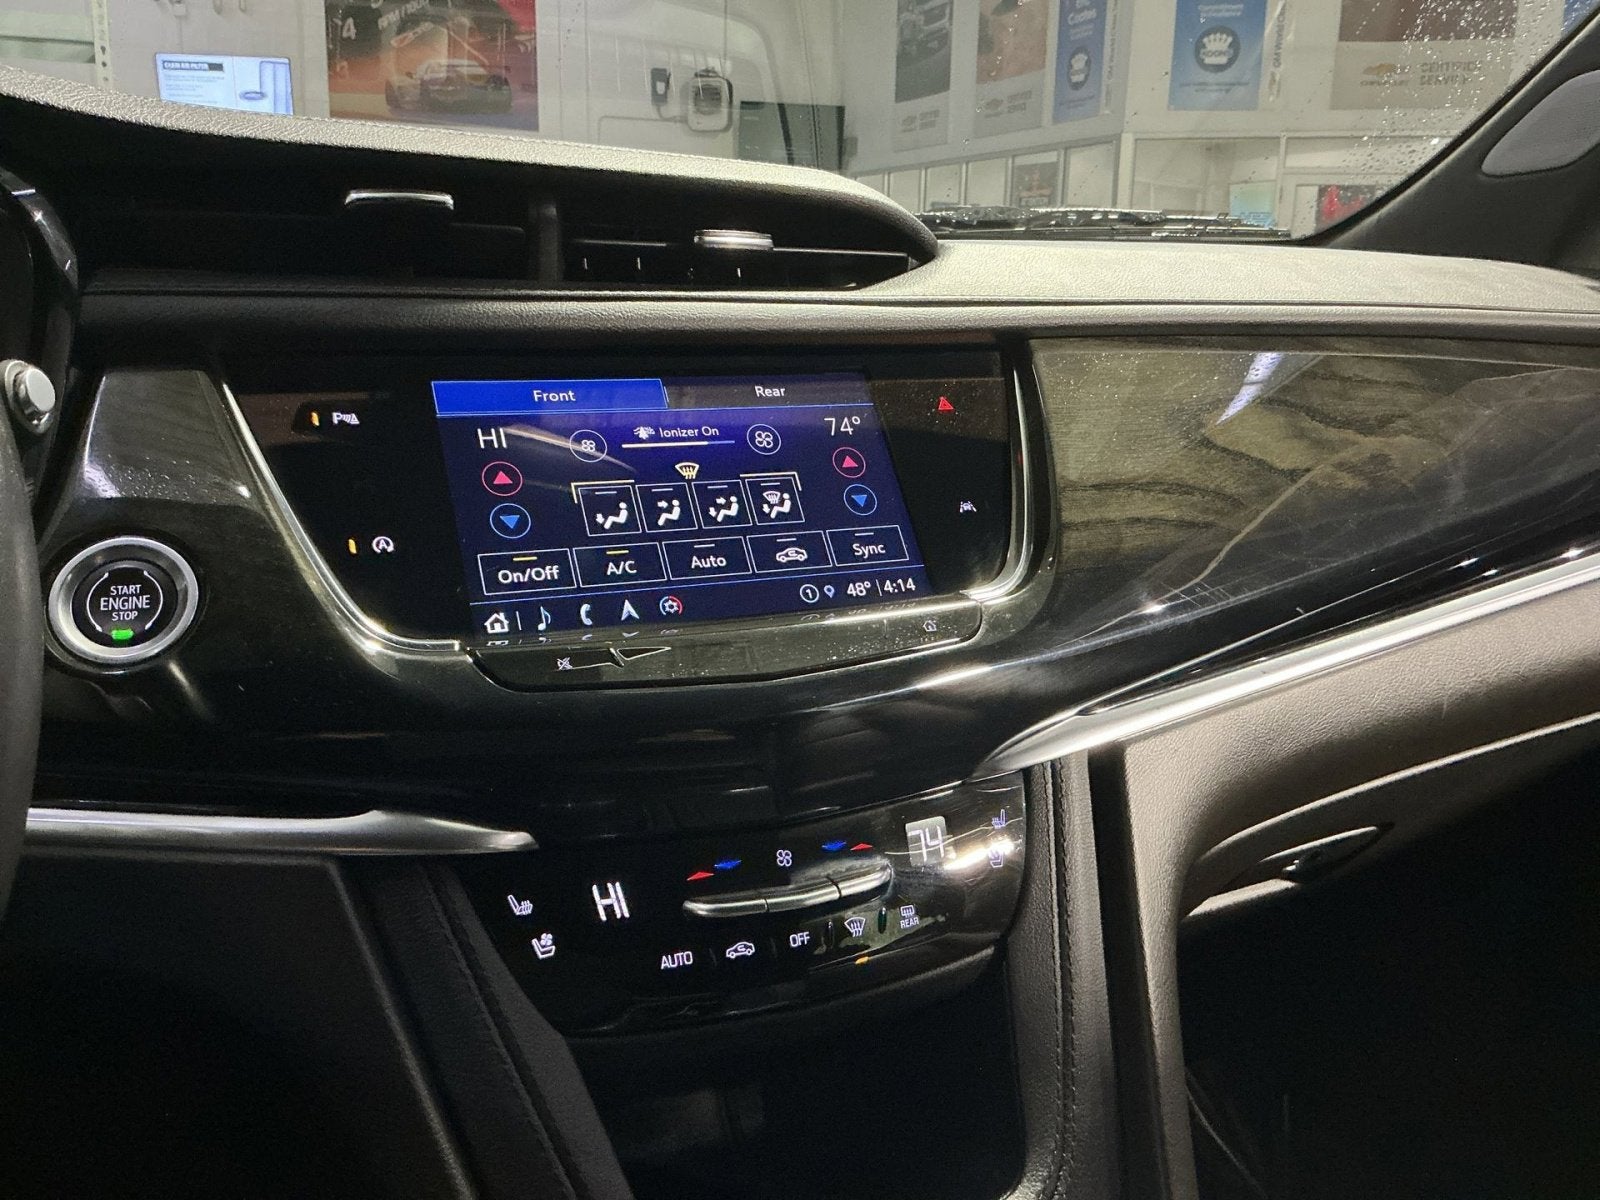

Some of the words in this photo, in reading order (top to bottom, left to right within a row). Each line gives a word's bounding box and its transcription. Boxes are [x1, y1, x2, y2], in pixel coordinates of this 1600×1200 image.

[532, 389, 577, 402] Front
[754, 385, 786, 398] Rear
[477, 428, 507, 449] HI
[658, 426, 699, 438] Ionizer
[701, 425, 720, 437] On
[852, 541, 886, 557] Sync
[606, 560, 638, 576] A/C
[691, 554, 727, 569] Auto
[497, 564, 560, 584] On/Off
[110, 584, 142, 596] START
[883, 577, 916, 594] 4:14
[100, 594, 151, 611] ENGINE
[112, 610, 139, 622] STOP
[907, 825, 945, 862] 74
[591, 881, 631, 922] HI
[899, 916, 920, 929] REAR
[789, 931, 811, 948] OFF
[660, 950, 694, 970] AUTO
